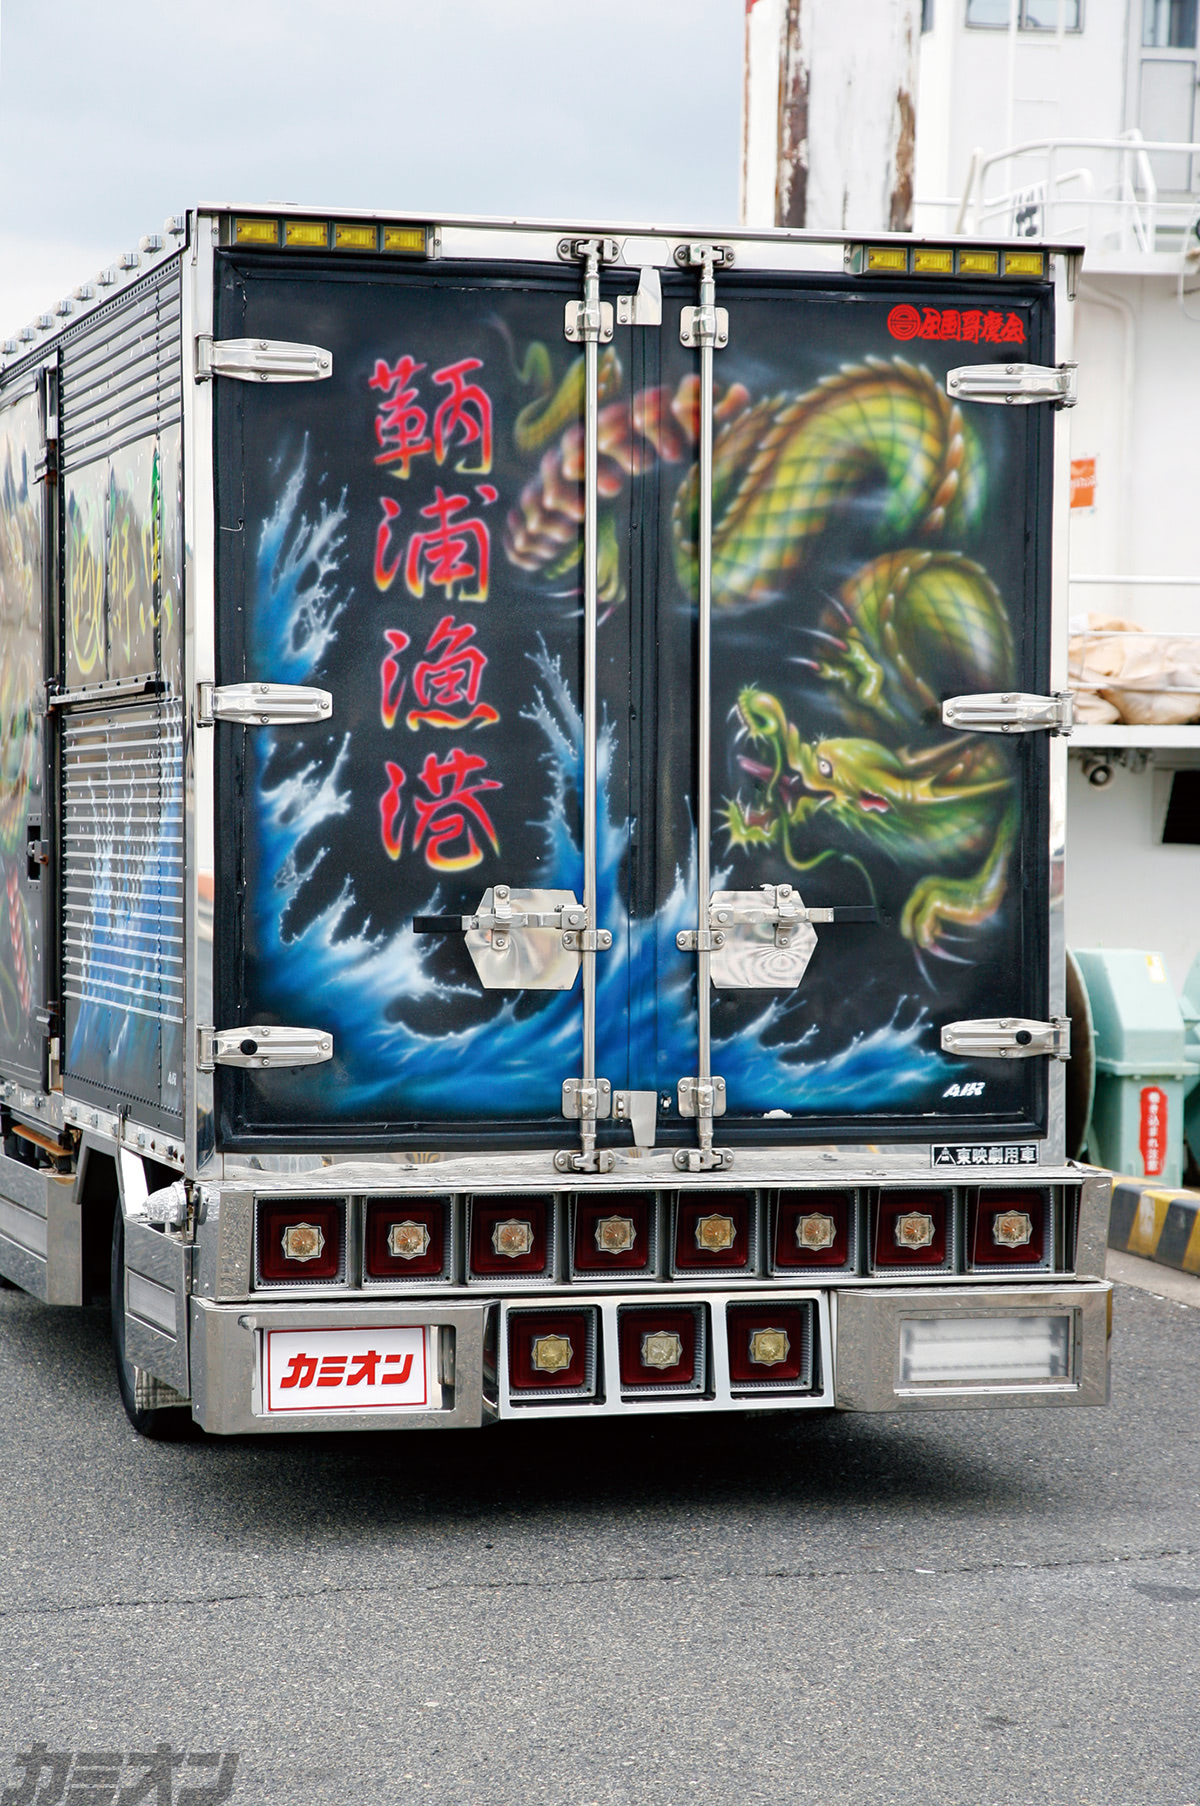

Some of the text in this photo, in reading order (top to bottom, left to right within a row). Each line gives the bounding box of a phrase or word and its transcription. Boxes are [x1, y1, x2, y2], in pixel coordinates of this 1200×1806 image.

[942, 1082, 986, 1098] AIR
[955, 1146, 1037, 1165] 東映劇用車
[280, 1350, 414, 1389] カミオン
